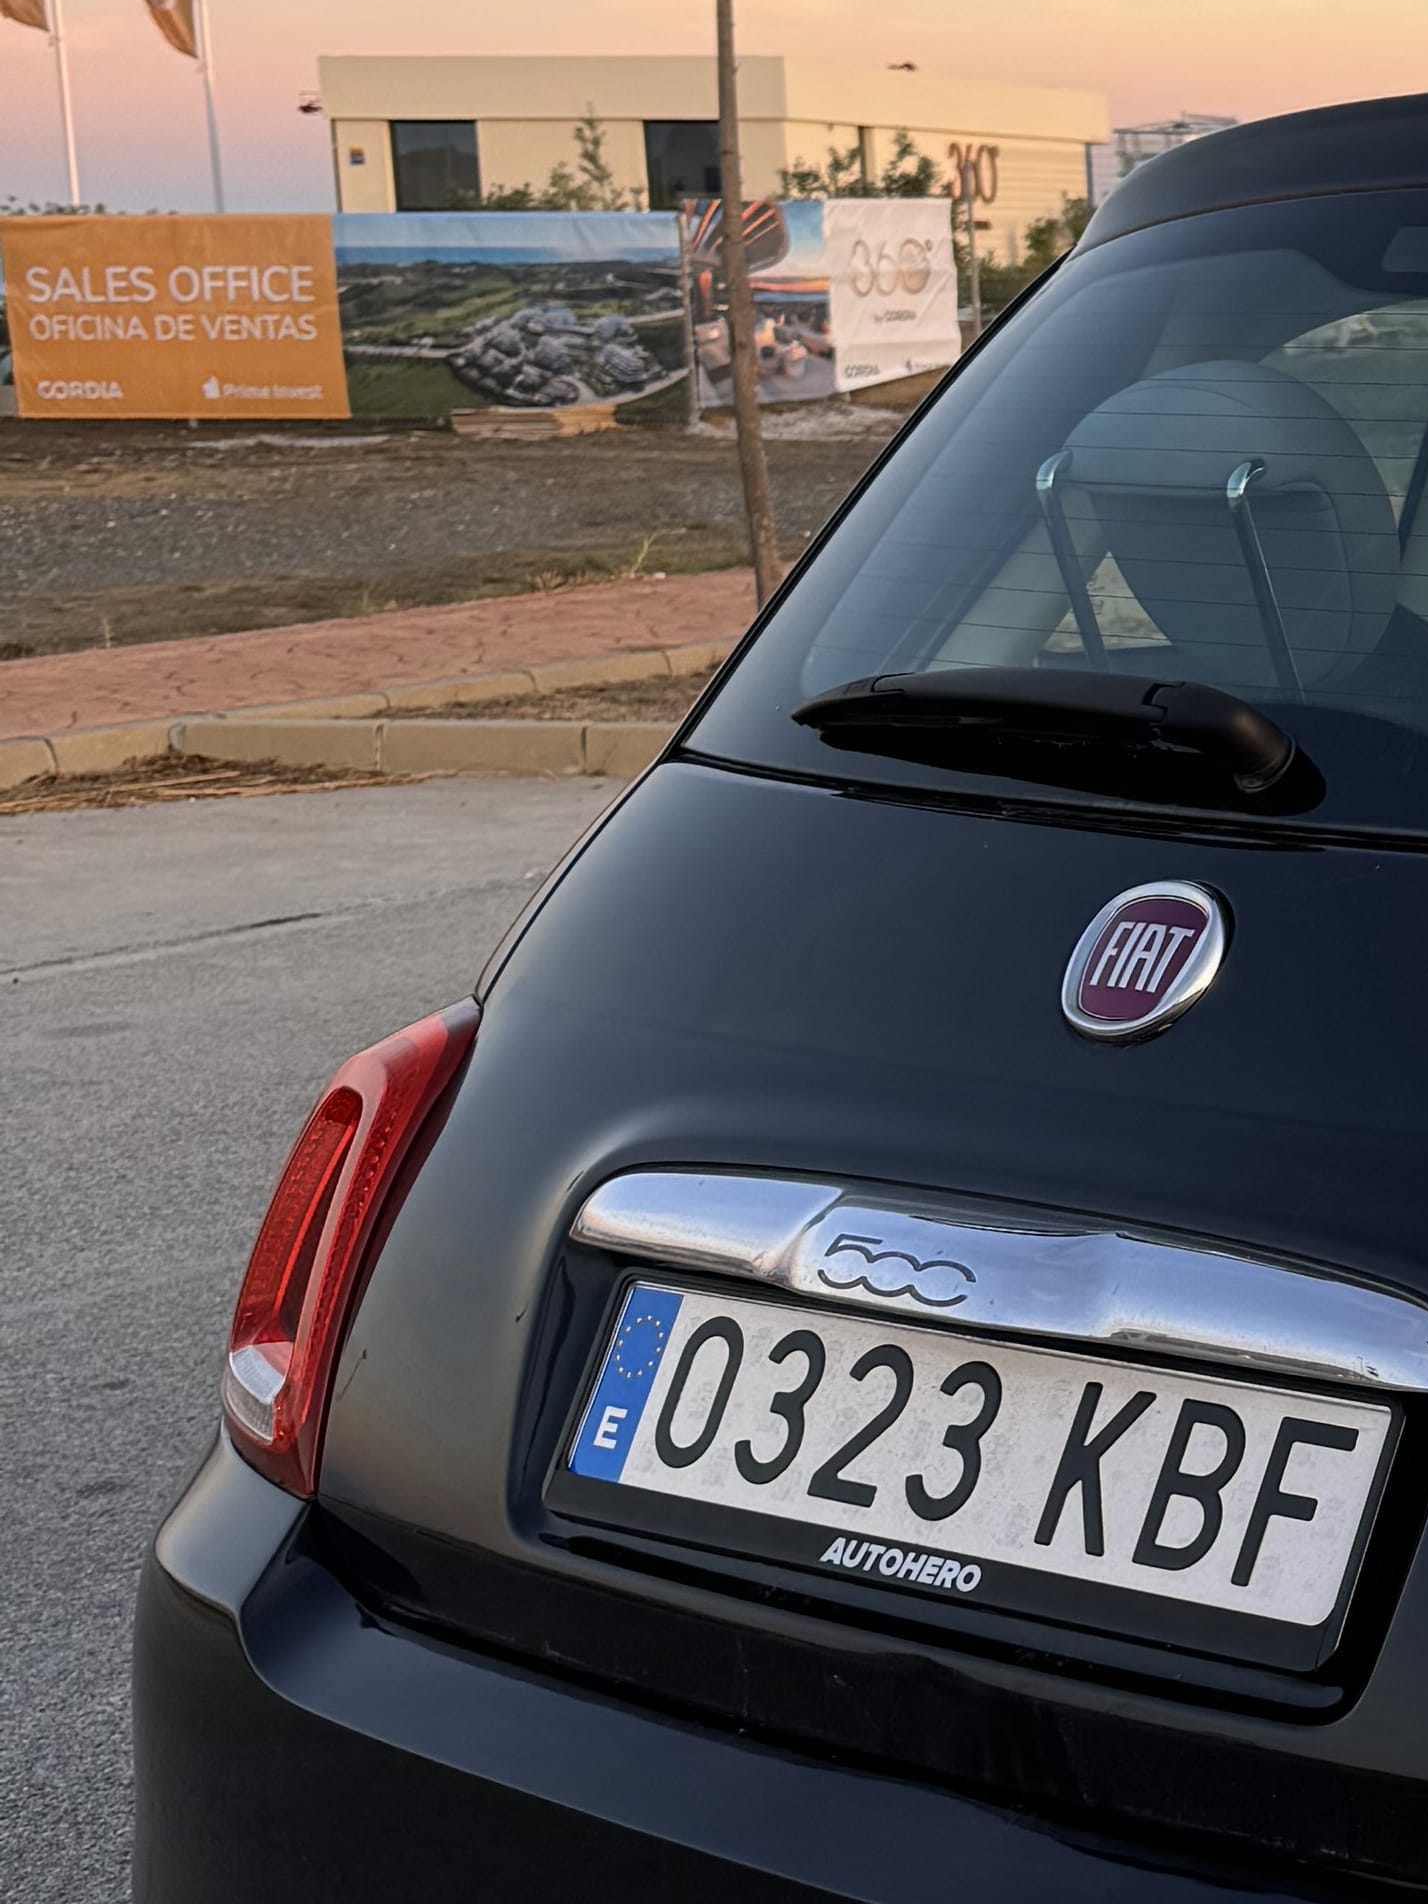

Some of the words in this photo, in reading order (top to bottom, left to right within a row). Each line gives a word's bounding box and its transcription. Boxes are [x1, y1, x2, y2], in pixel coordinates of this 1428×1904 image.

[25, 266, 157, 303] SALES
[167, 265, 316, 302] OFFICE
[29, 314, 149, 341] OFICINA
[153, 314, 196, 341] DE
[200, 314, 318, 341] VENTAS
[37, 381, 124, 400] CORDIA
[222, 384, 270, 398] Prime
[1089, 921, 1195, 993] FIAT
[817, 1233, 977, 1308] 500
[592, 1405, 628, 1450] E
[654, 1315, 1002, 1522] 0323
[1033, 1381, 1360, 1588] KBF
[819, 1536, 982, 1593] AUTOHERO
